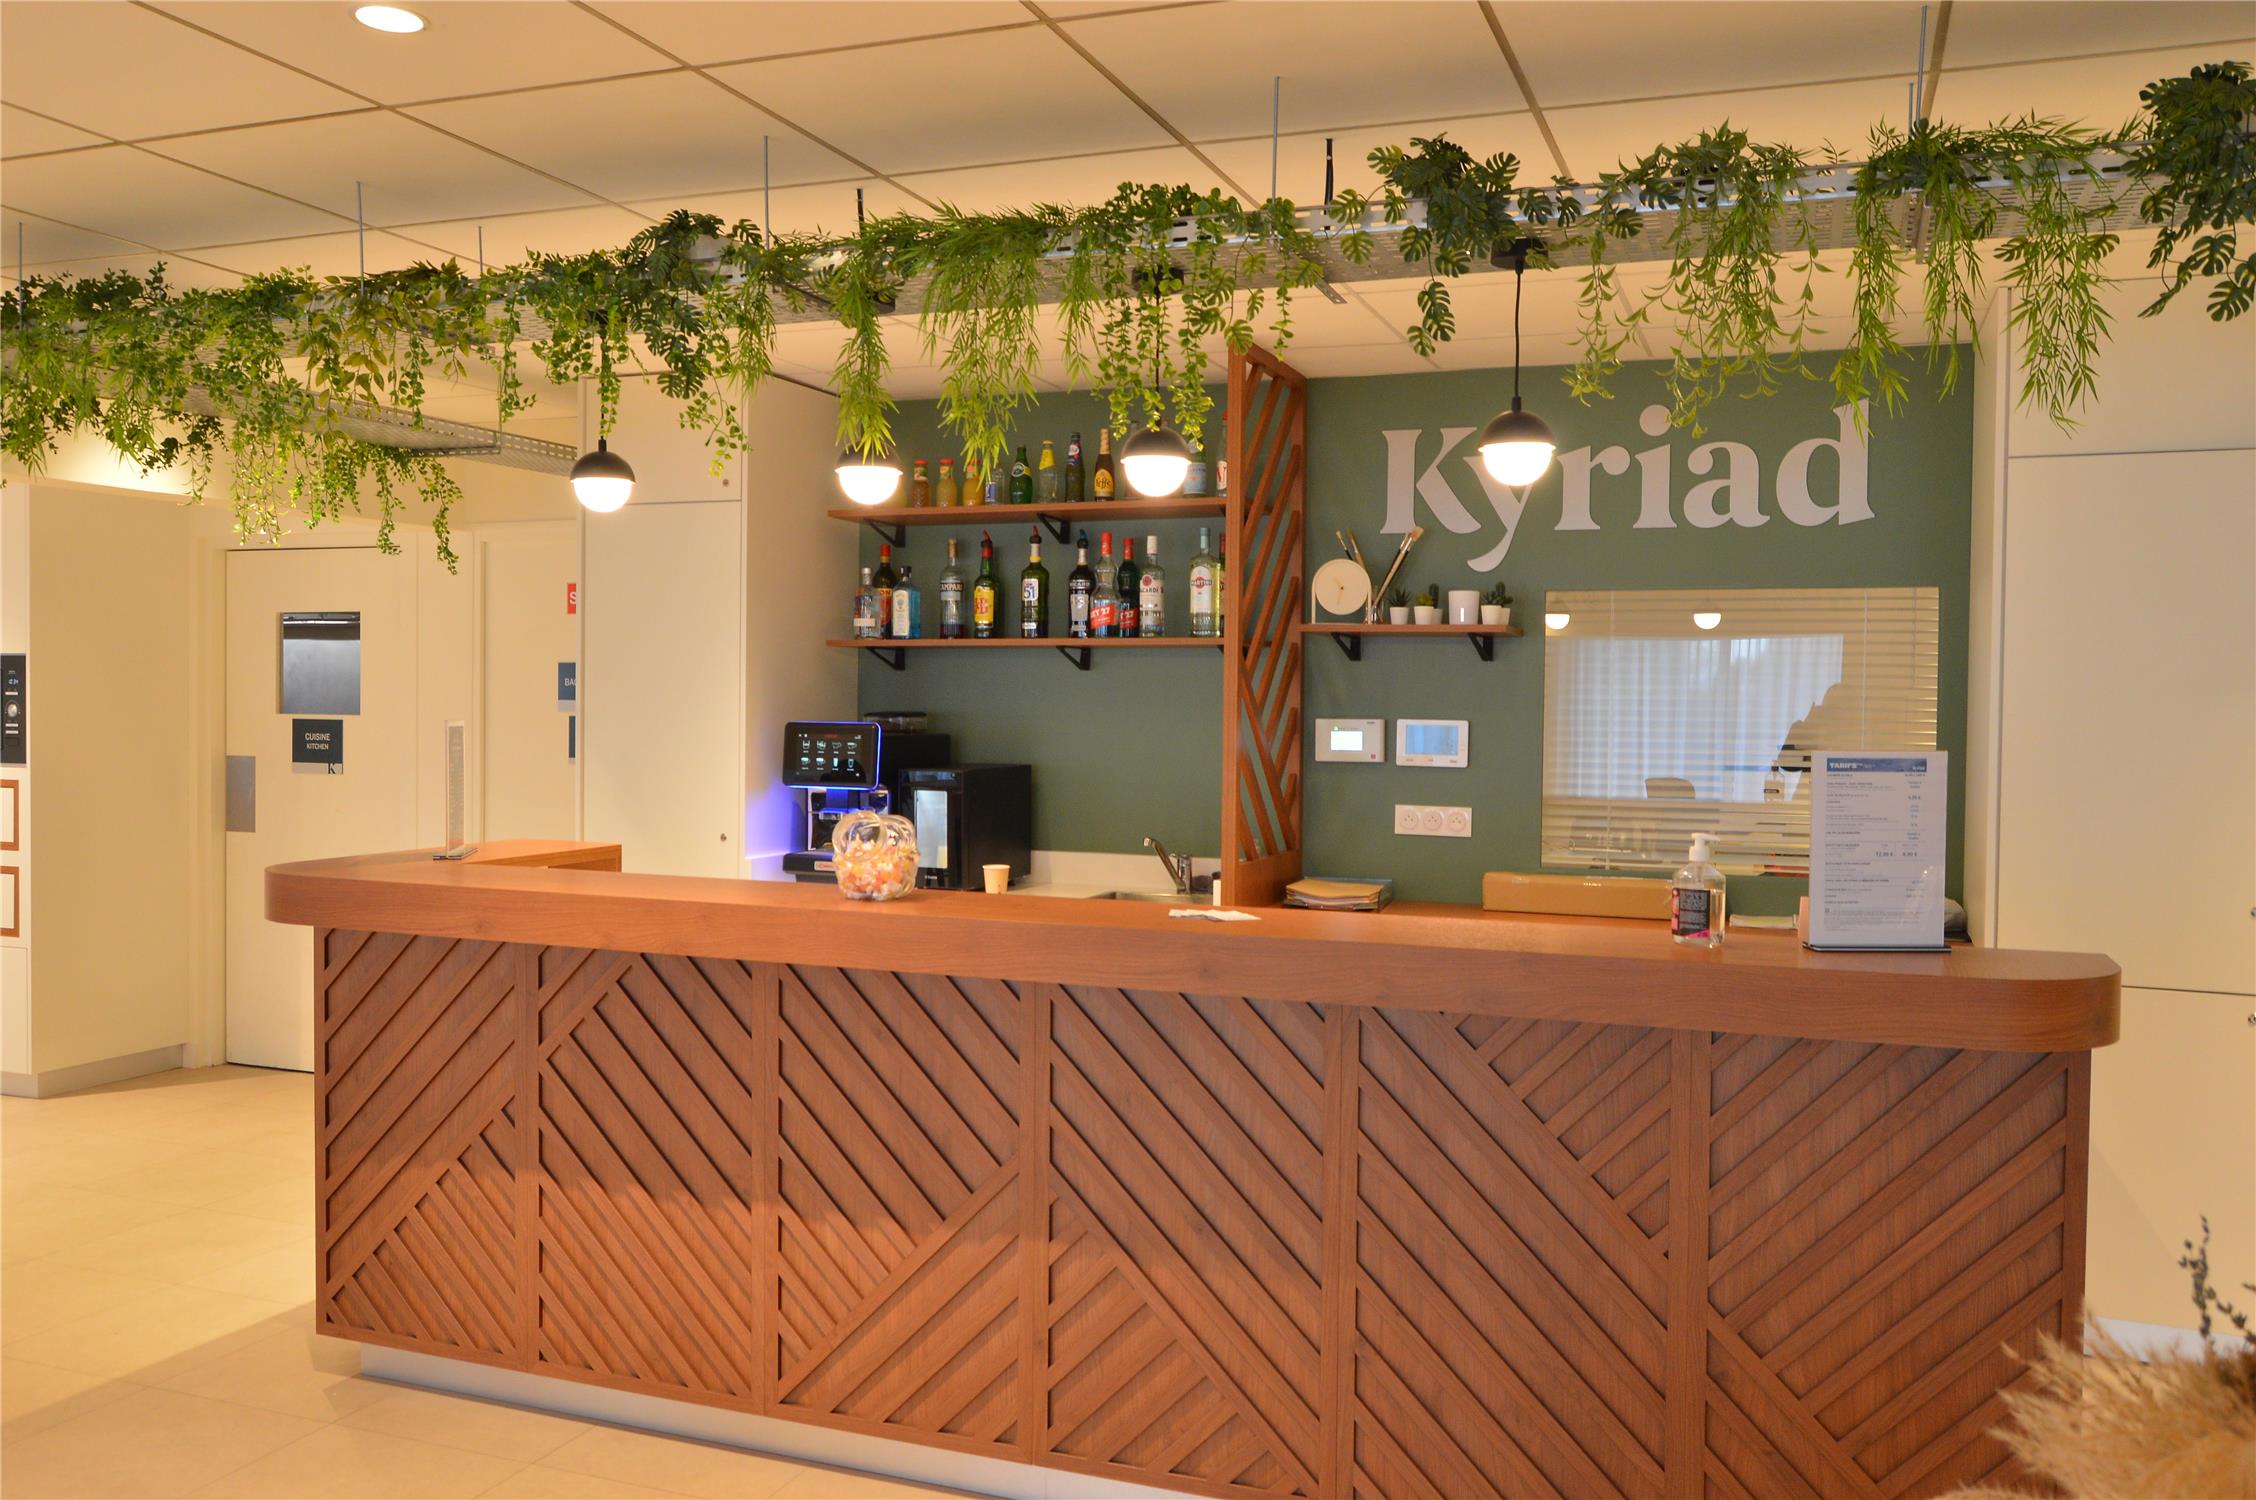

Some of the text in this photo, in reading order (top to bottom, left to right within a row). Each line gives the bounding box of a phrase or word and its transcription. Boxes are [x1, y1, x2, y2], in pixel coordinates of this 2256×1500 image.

[1380, 398, 1876, 573] Kyriad
[1024, 586, 1035, 599] 51
[304, 732, 331, 741] CUISINE
